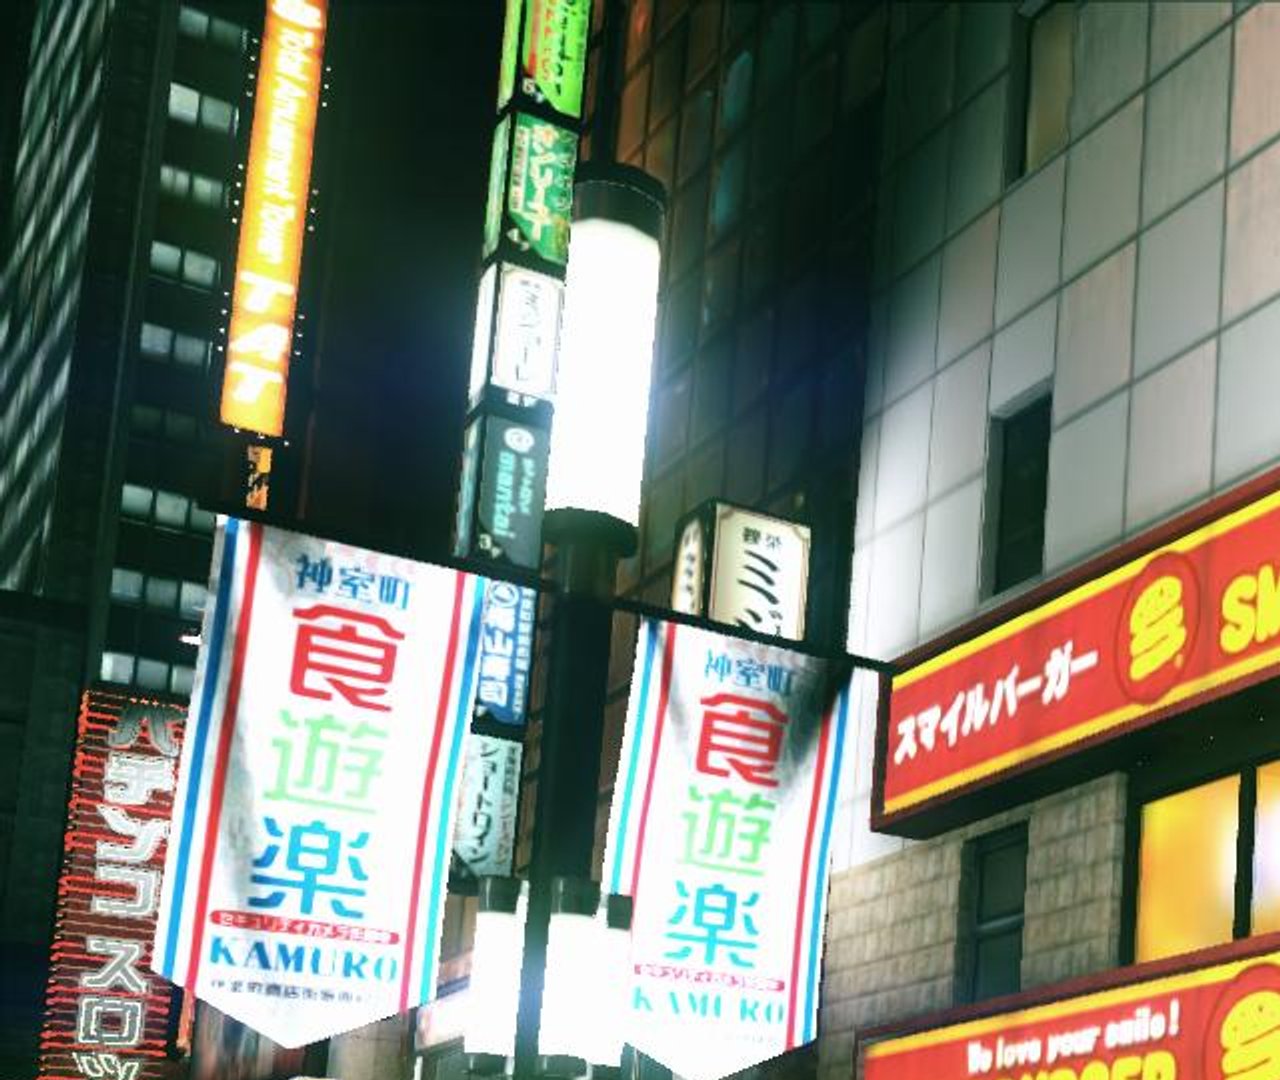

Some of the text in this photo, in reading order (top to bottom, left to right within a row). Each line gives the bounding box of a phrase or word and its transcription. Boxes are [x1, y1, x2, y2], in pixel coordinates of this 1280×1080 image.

[295, 554, 415, 610] 神室町
[894, 637, 1099, 764] スマイルバーガー
[248, 604, 405, 920] 食遊楽
[663, 691, 789, 969] 食遊楽
[208, 934, 399, 983] KAMURO
[967, 1000, 1181, 1077] We love your smile!
